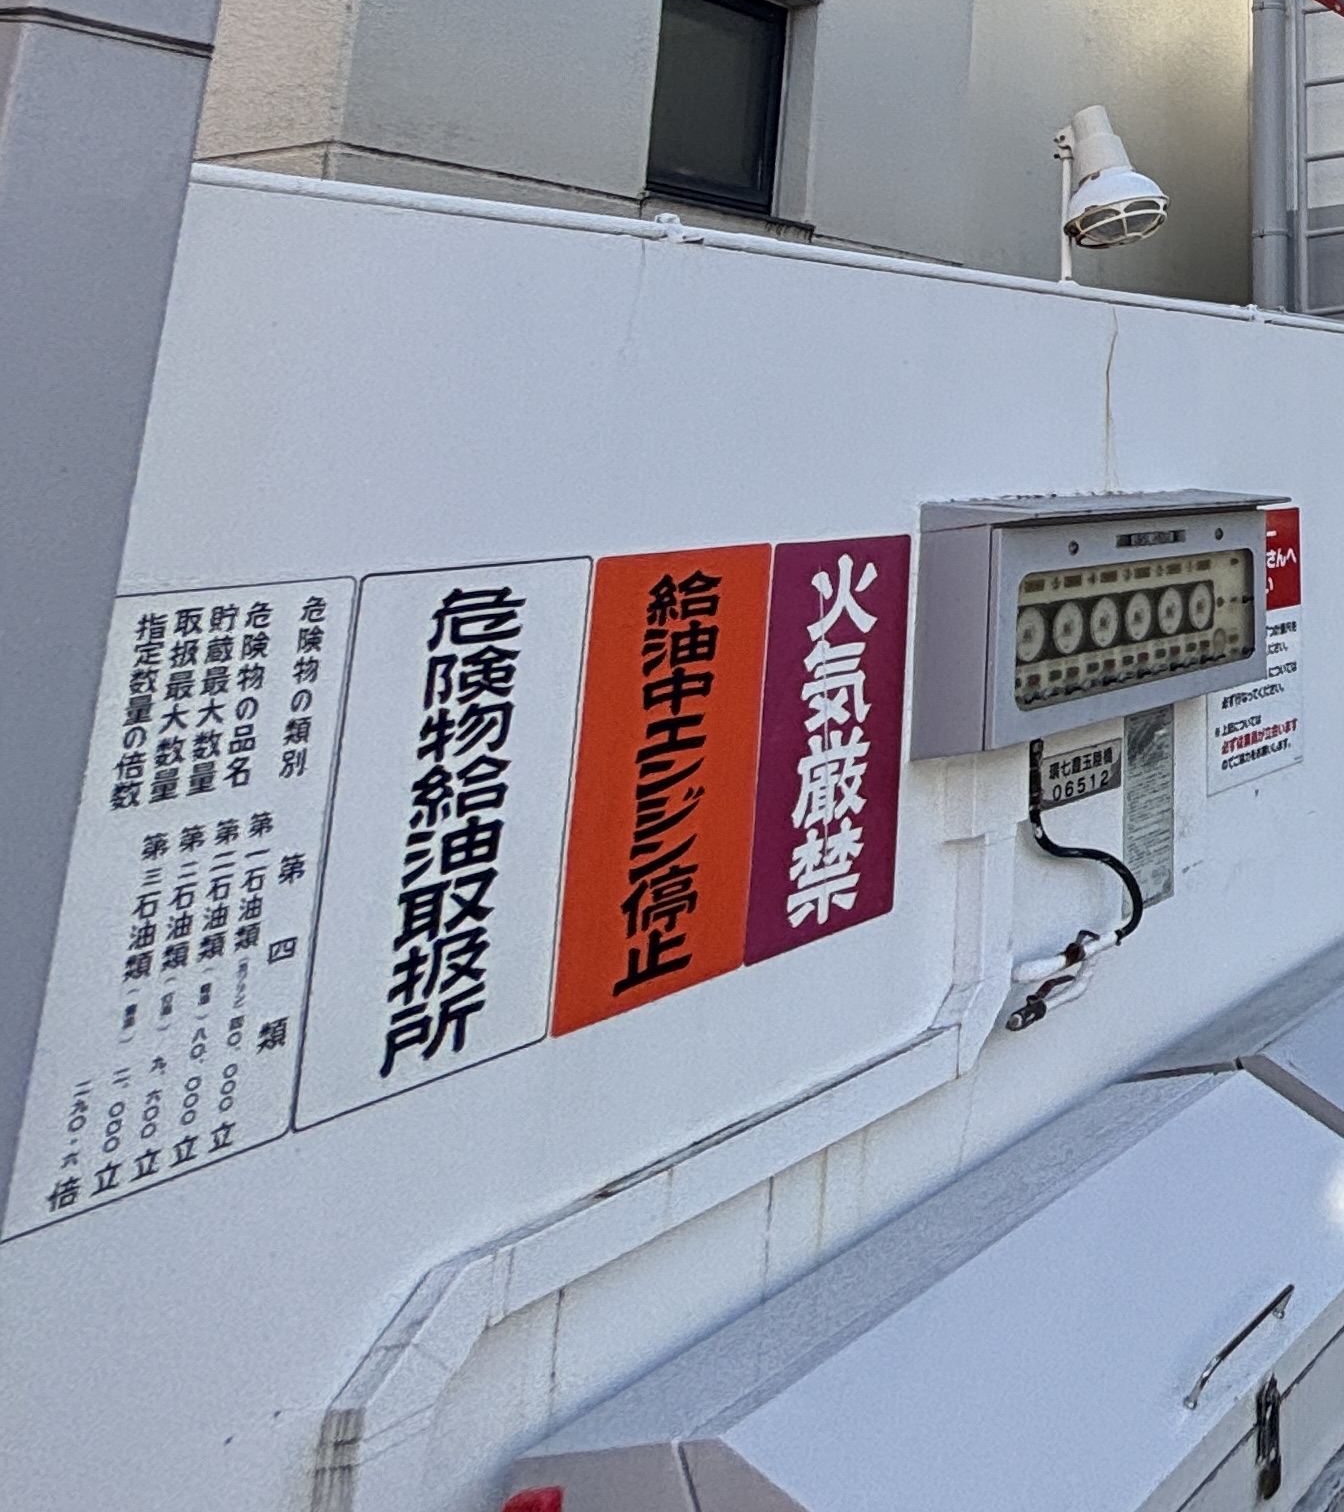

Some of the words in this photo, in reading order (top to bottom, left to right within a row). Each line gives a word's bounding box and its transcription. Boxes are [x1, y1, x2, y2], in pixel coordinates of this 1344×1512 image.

[110, 613, 168, 811] 指定数量の倍数
[148, 606, 204, 805] 取扱最大数量
[185, 604, 239, 797] 貯蔵最大数量
[222, 601, 273, 789] 危険物の品名
[279, 596, 327, 779] 危険物の類別
[612, 570, 722, 997] 給油中エンジン停止
[785, 553, 878, 928] 火気厳禁
[380, 586, 527, 1079] 危険物給油取扱所
[1053, 770, 1109, 801] 06512
[197, 818, 240, 962] 第二石油類
[233, 811, 273, 954] 第一石油類
